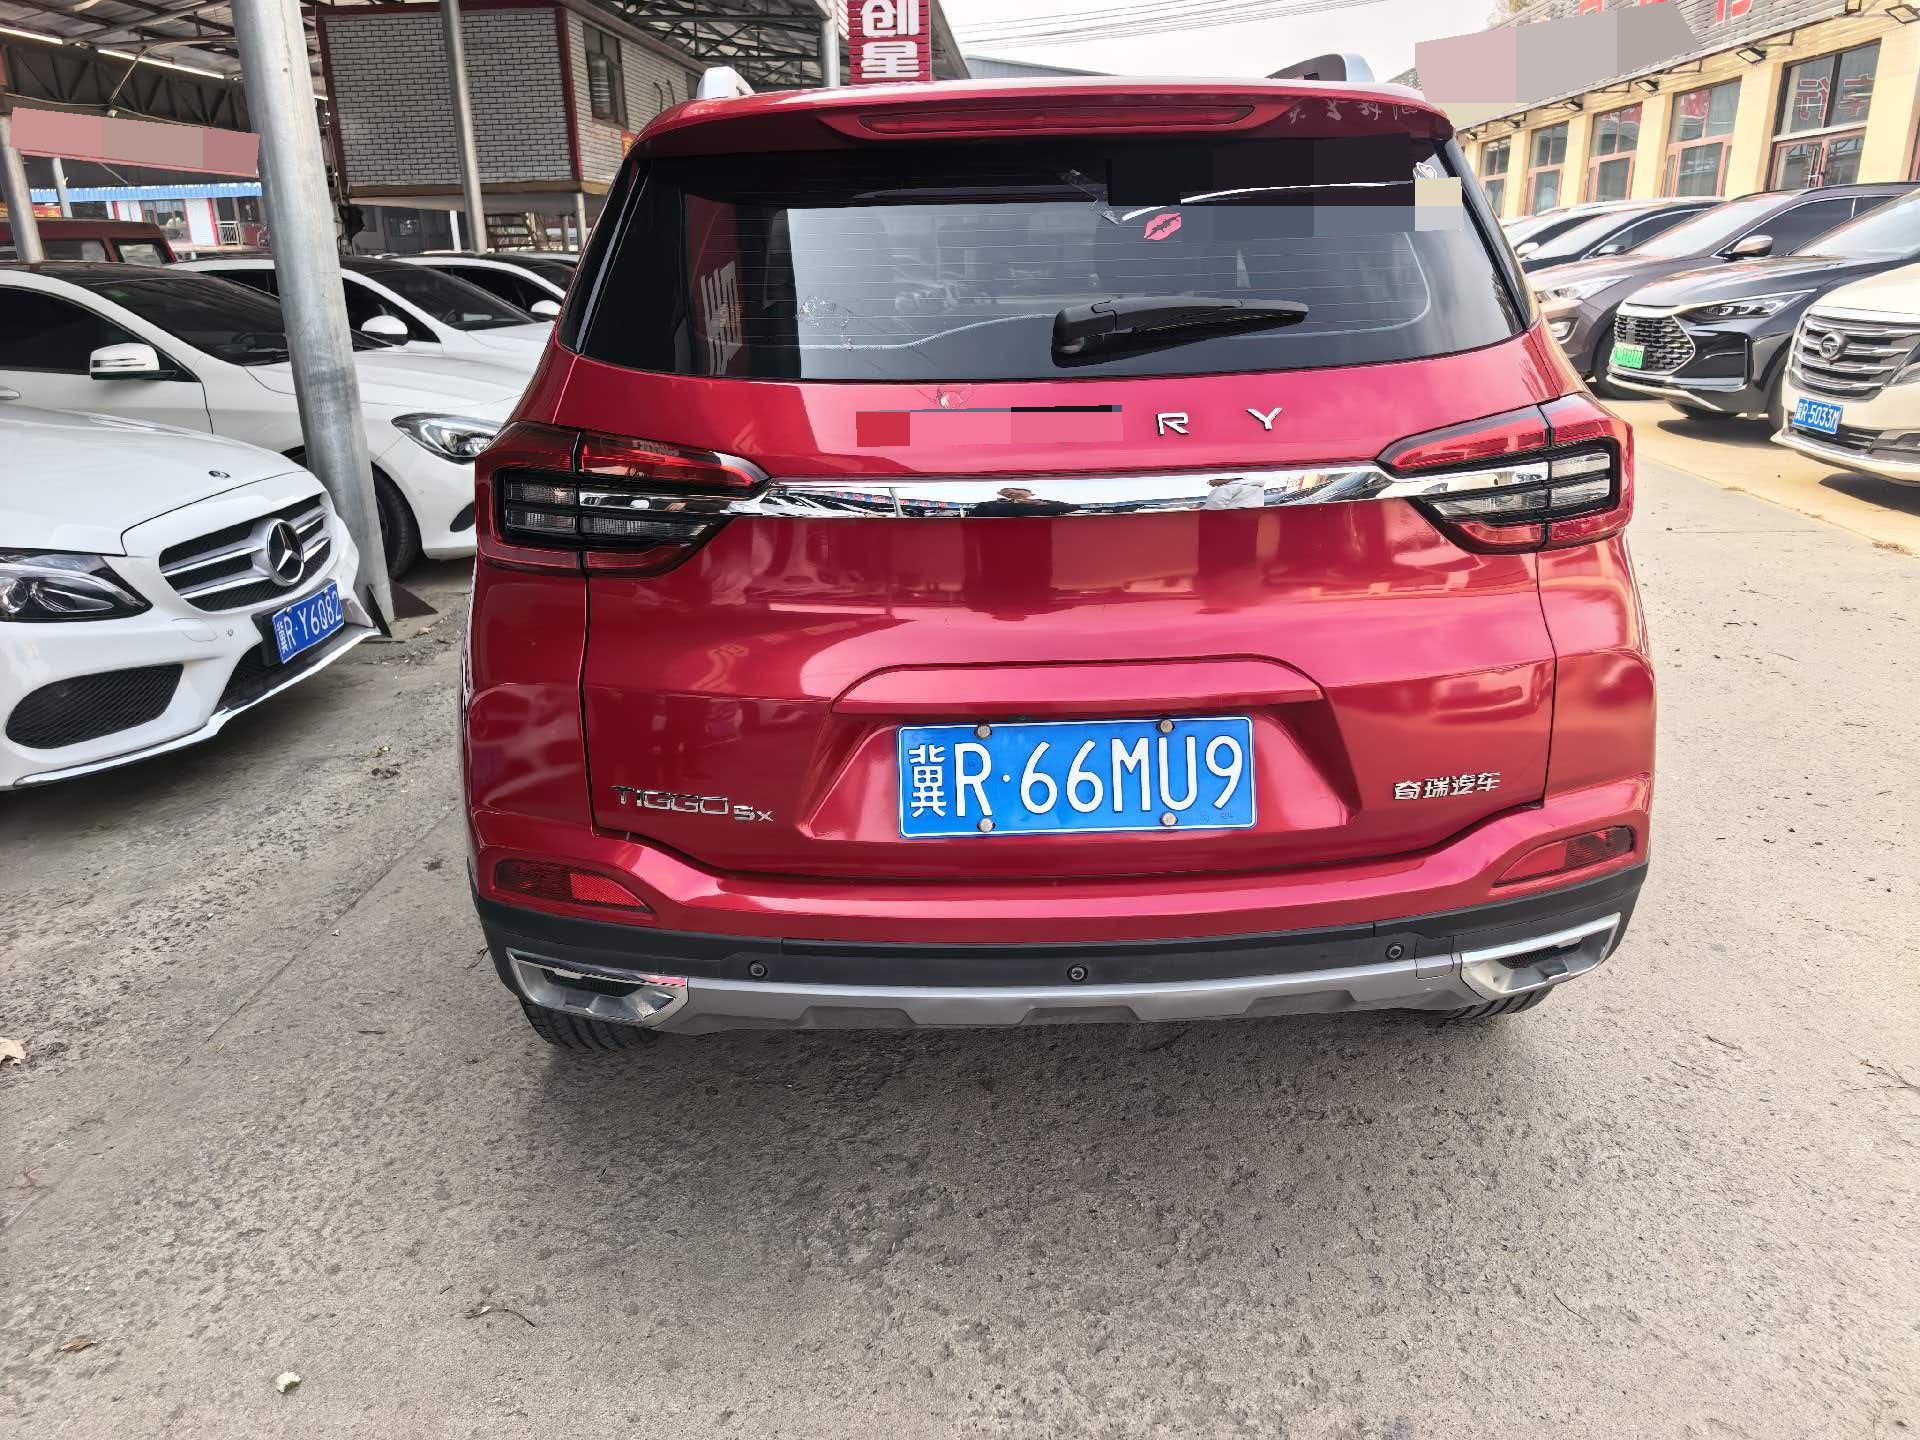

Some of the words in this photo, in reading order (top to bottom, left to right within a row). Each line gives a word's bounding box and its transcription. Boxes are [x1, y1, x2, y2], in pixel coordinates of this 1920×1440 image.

[859, 0, 921, 79] 创星
[610, 785, 730, 816] TIGGO
[907, 734, 1244, 819] 冀R·66MU9
[1394, 771, 1503, 801] 奇瑞汽车
